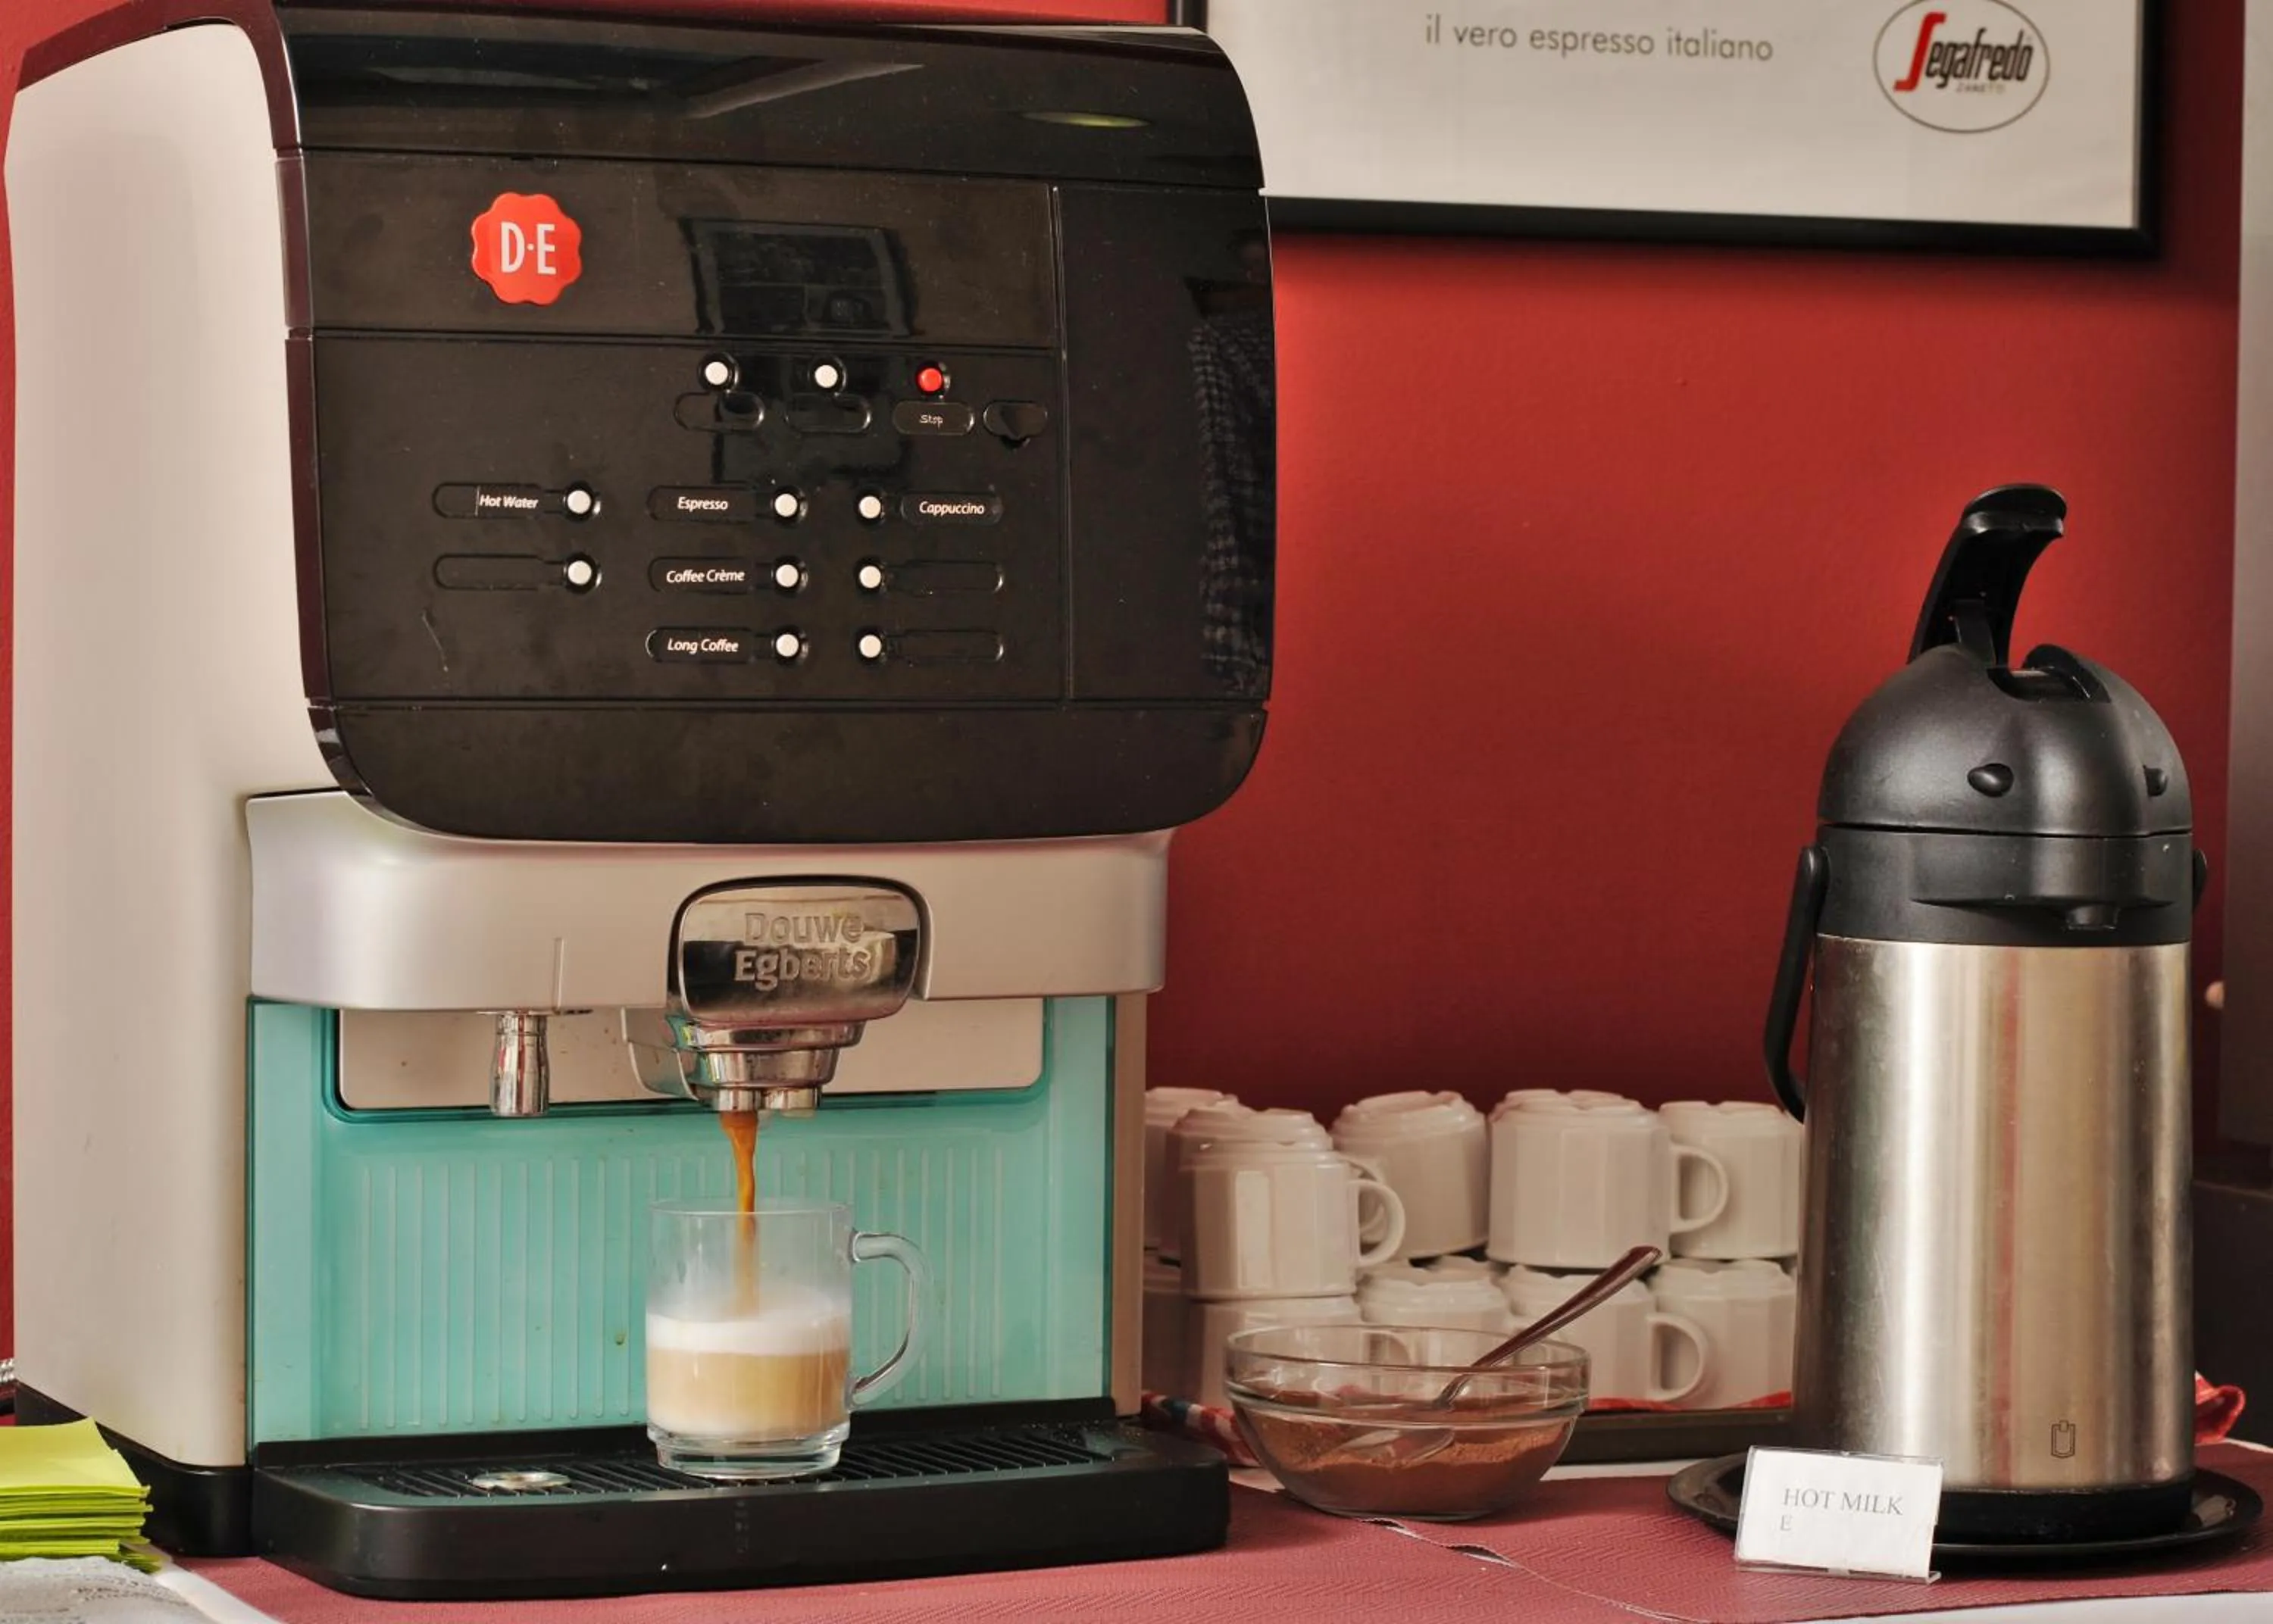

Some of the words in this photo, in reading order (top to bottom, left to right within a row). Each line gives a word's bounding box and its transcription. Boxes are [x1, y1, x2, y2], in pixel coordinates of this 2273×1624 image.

[1425, 14, 1441, 45] il
[1453, 25, 1517, 48] vero
[1529, 28, 1656, 59] espresso
[1667, 27, 1774, 61] italiano
[1893, 11, 2034, 92] Segafredo
[919, 414, 944, 429] Stop
[479, 494, 501, 507] Hot
[502, 495, 539, 509] Water
[677, 496, 729, 513] Espresso
[918, 501, 985, 517] Cappuccino
[666, 569, 705, 583] Coffee
[705, 569, 746, 582] Crème
[667, 638, 698, 655] Long
[700, 638, 739, 653] Coffee
[744, 912, 864, 946] Douwe
[733, 945, 872, 992] Egberts
[1783, 1488, 1837, 1510] HOT
[1840, 1491, 1904, 1516] MILK
